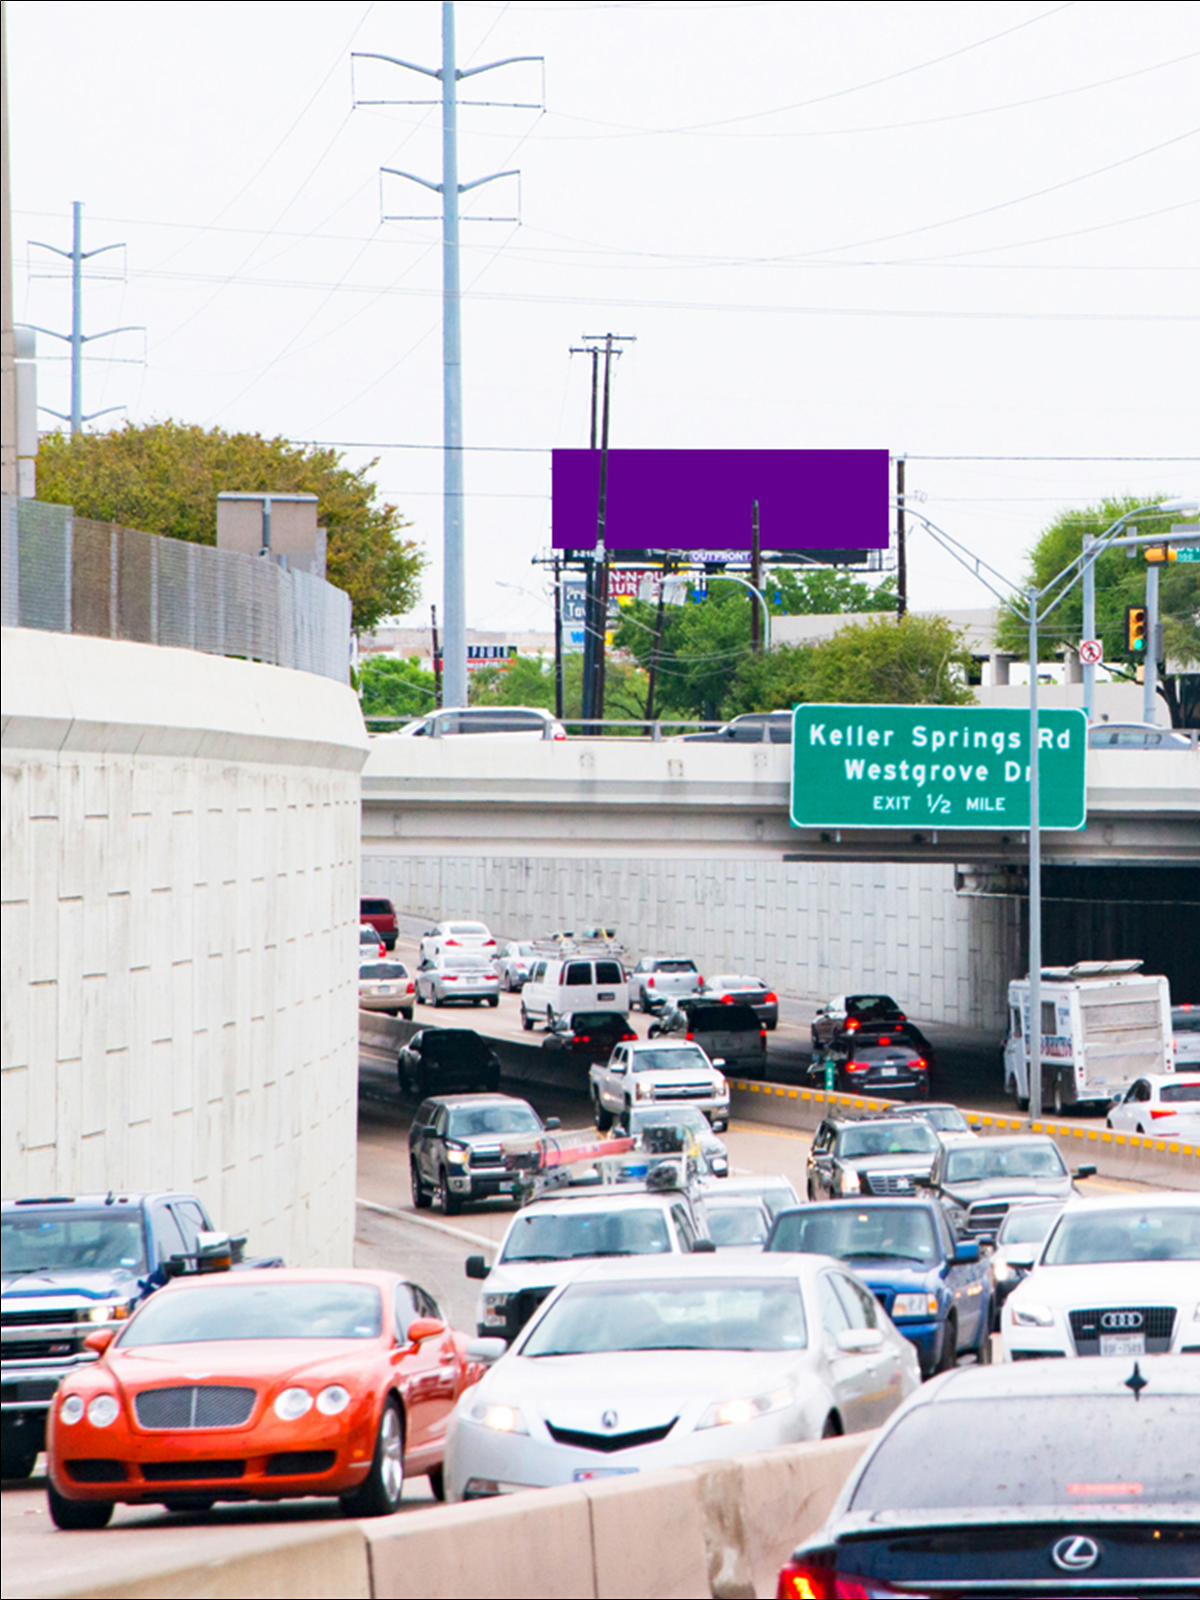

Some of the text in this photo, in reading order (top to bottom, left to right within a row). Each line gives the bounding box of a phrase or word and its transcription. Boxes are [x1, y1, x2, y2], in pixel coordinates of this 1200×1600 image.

[692, 552, 750, 561] OUTFRONT
[608, 571, 664, 583] N-N-OU
[809, 724, 1070, 755] Keller Springs Rd
[845, 759, 989, 788] Westgrove
[873, 796, 911, 810] EXIT
[966, 797, 1006, 811] MILE
